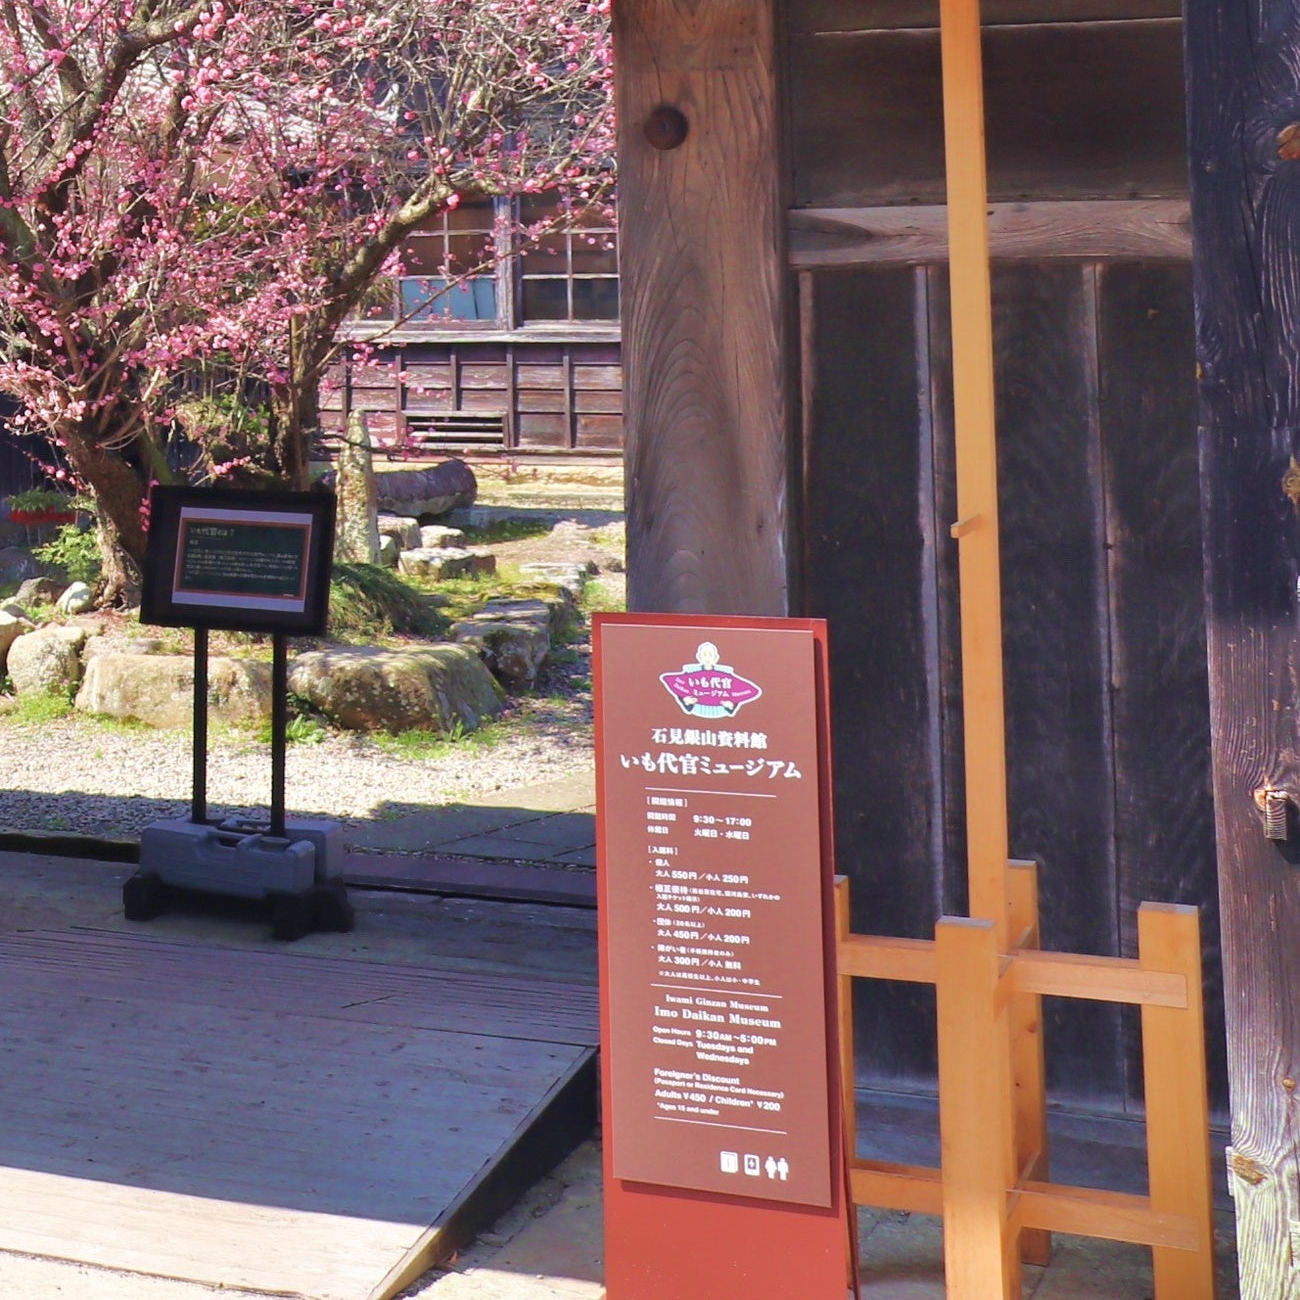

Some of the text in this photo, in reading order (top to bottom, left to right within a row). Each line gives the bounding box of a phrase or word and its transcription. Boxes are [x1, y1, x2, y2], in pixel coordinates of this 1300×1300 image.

[688, 676, 732, 689] いも代官
[693, 689, 730, 697] ミュージアム
[651, 728, 767, 750] 石見銀山資料館
[620, 752, 802, 779] いも代官ミュージアム
[693, 814, 752, 826] 9:30～17:00
[647, 826, 750, 840] 休館日 火曜日・水曜日
[666, 994, 768, 1012] Iwami Ginzan Museum
[654, 1006, 782, 1028] Imo Daikan Museum
[652, 1026, 670, 1035] Open
[671, 1027, 691, 1036] Hours
[652, 1037, 754, 1054] Closed Days Tuesdays and
[696, 1052, 750, 1065] Wednesdays
[654, 1068, 740, 1084] Foreigner's Discount
[654, 1078, 686, 1088] (Passport
[695, 1082, 729, 1092] Residence
[730, 1086, 746, 1094] Card
[747, 1088, 784, 1099] Necessary)
[654, 1089, 682, 1099] Adults
[700, 1108, 719, 1116] under
